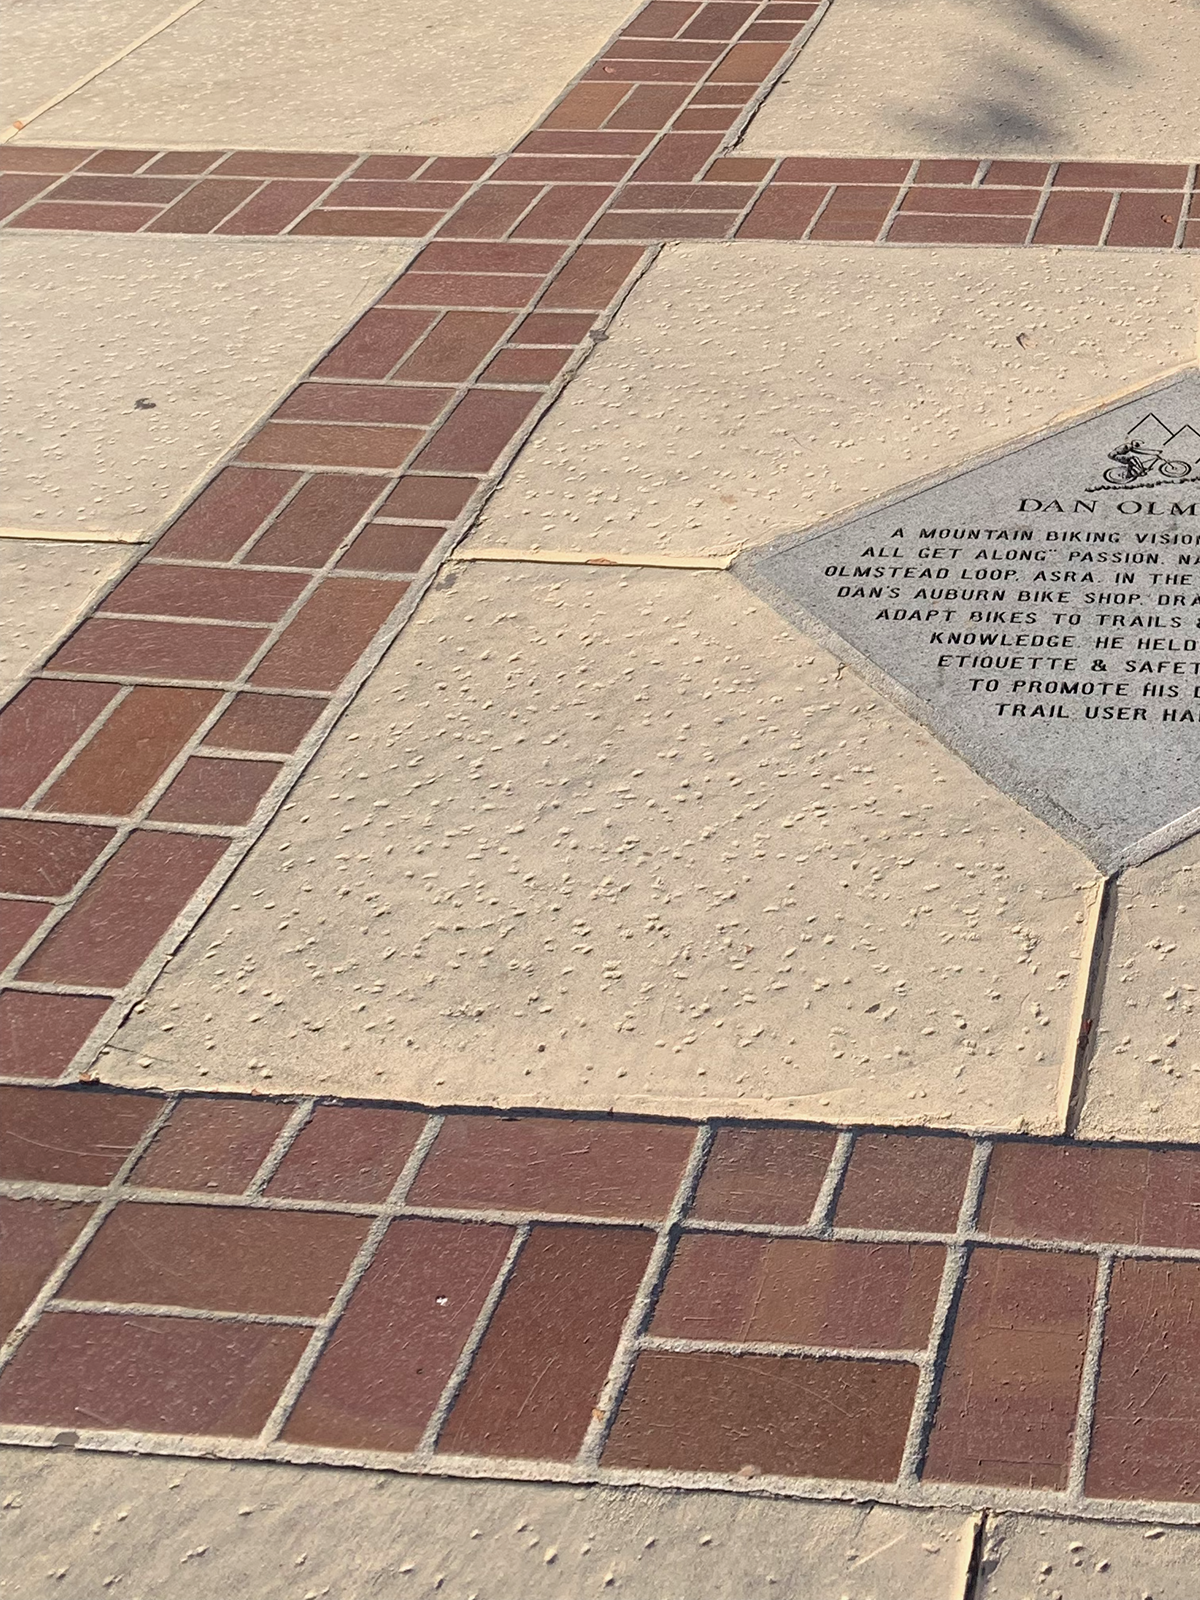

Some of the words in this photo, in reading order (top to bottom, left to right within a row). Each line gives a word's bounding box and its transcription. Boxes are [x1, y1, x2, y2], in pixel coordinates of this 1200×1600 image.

[1017, 498, 1098, 513] DAN
[890, 527, 904, 538] A
[918, 528, 1034, 541] MOUNTAIN
[1045, 530, 1120, 544] BIKING
[860, 546, 904, 558] ALL
[918, 546, 963, 559] GET
[1068, 551, 1166, 566] PASSION.
[824, 565, 950, 580] OLMSTEAD
[1115, 572, 1135, 584] IN
[1152, 573, 1193, 586] THE
[836, 585, 901, 599] DAN'S
[913, 588, 1006, 602] AUBURN
[1017, 590, 1071, 604] BIKE
[875, 608, 957, 622] ADAPT
[969, 611, 1037, 625] BIKES
[1052, 613, 1082, 626] TO
[1095, 614, 1182, 629] TRAILS
[1095, 636, 1125, 650] HE
[1137, 637, 1197, 652] HELD
[937, 654, 1078, 671] ETIQUETTE
[1090, 659, 1108, 672] &
[968, 678, 1000, 693] TO
[1012, 679, 1130, 697] PROMOTE
[1142, 681, 1179, 698] HIS
[997, 703, 1070, 719] TRAIL
[1085, 706, 1147, 721] USER
